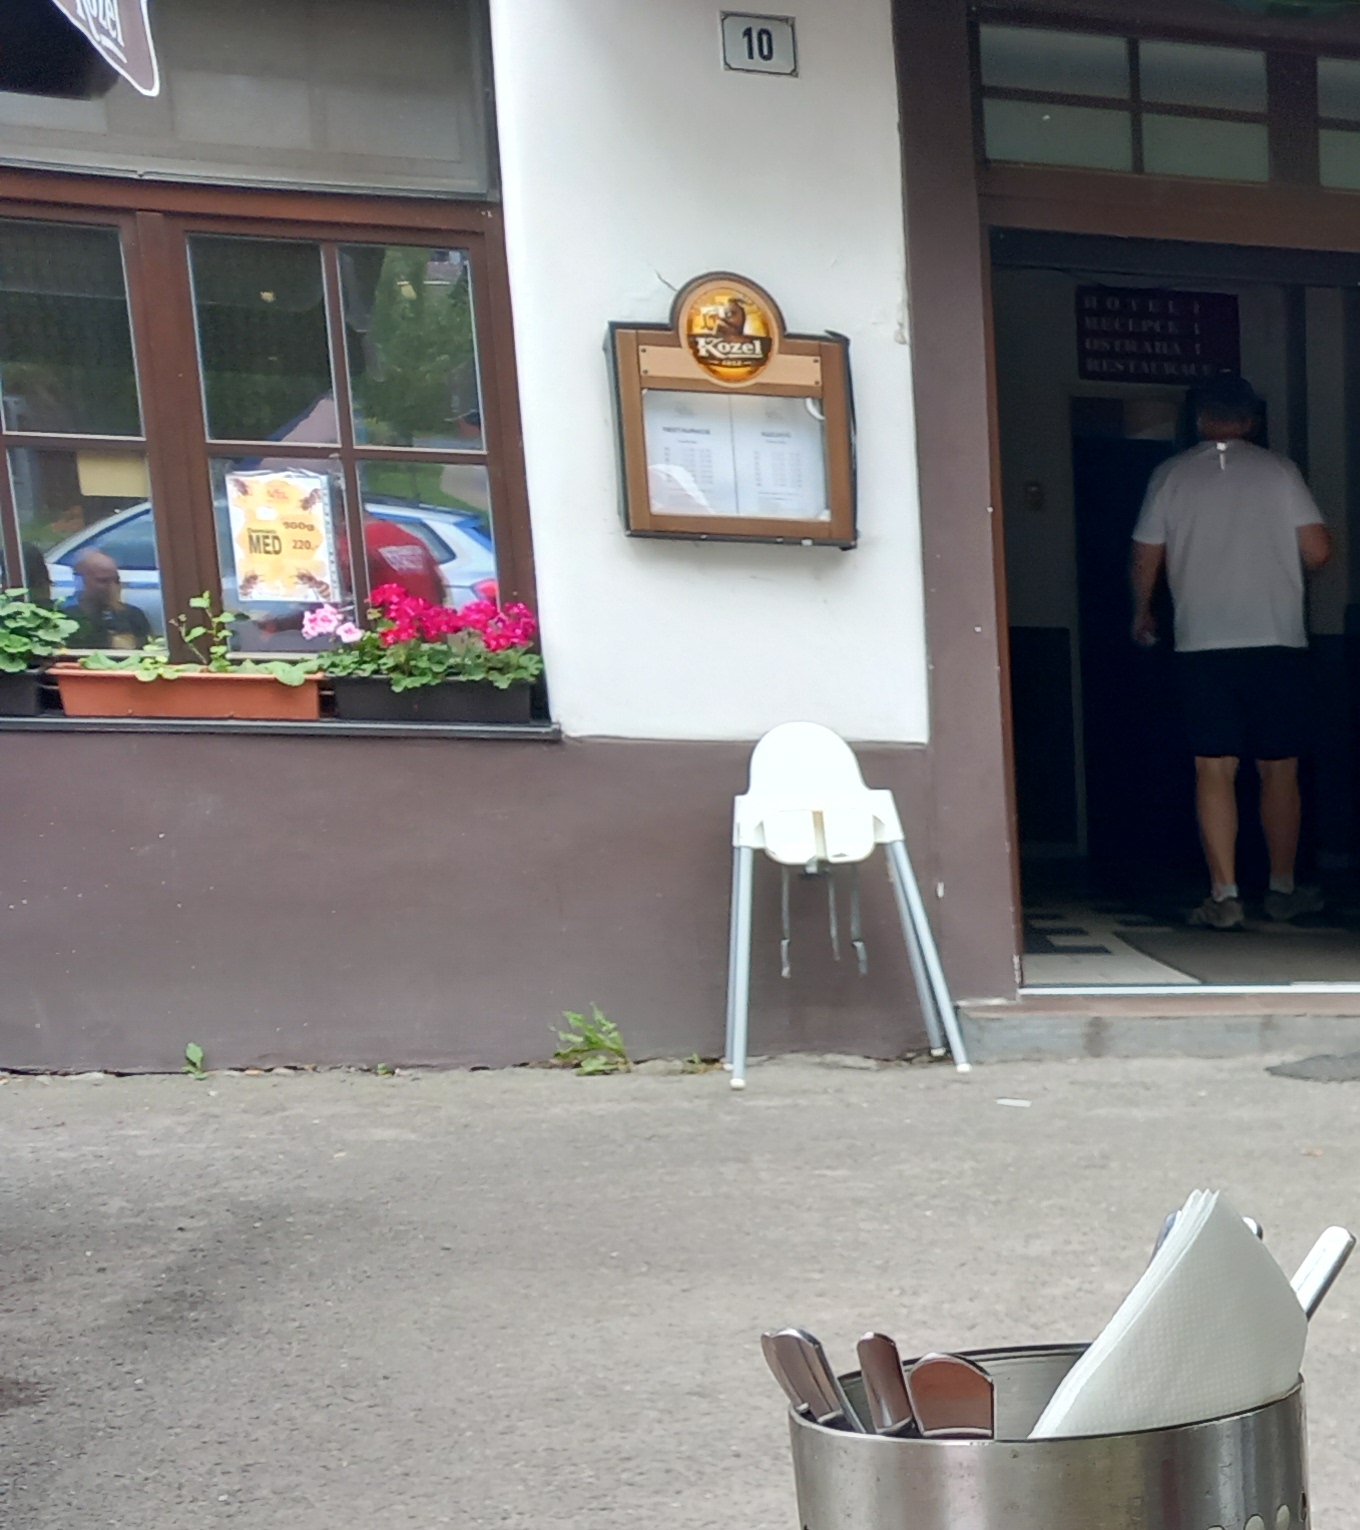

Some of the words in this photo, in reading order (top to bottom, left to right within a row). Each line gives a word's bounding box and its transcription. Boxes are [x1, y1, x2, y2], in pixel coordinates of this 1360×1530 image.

[742, 26, 773, 61] 10
[695, 337, 763, 359] Kozel
[248, 534, 282, 555] MED
